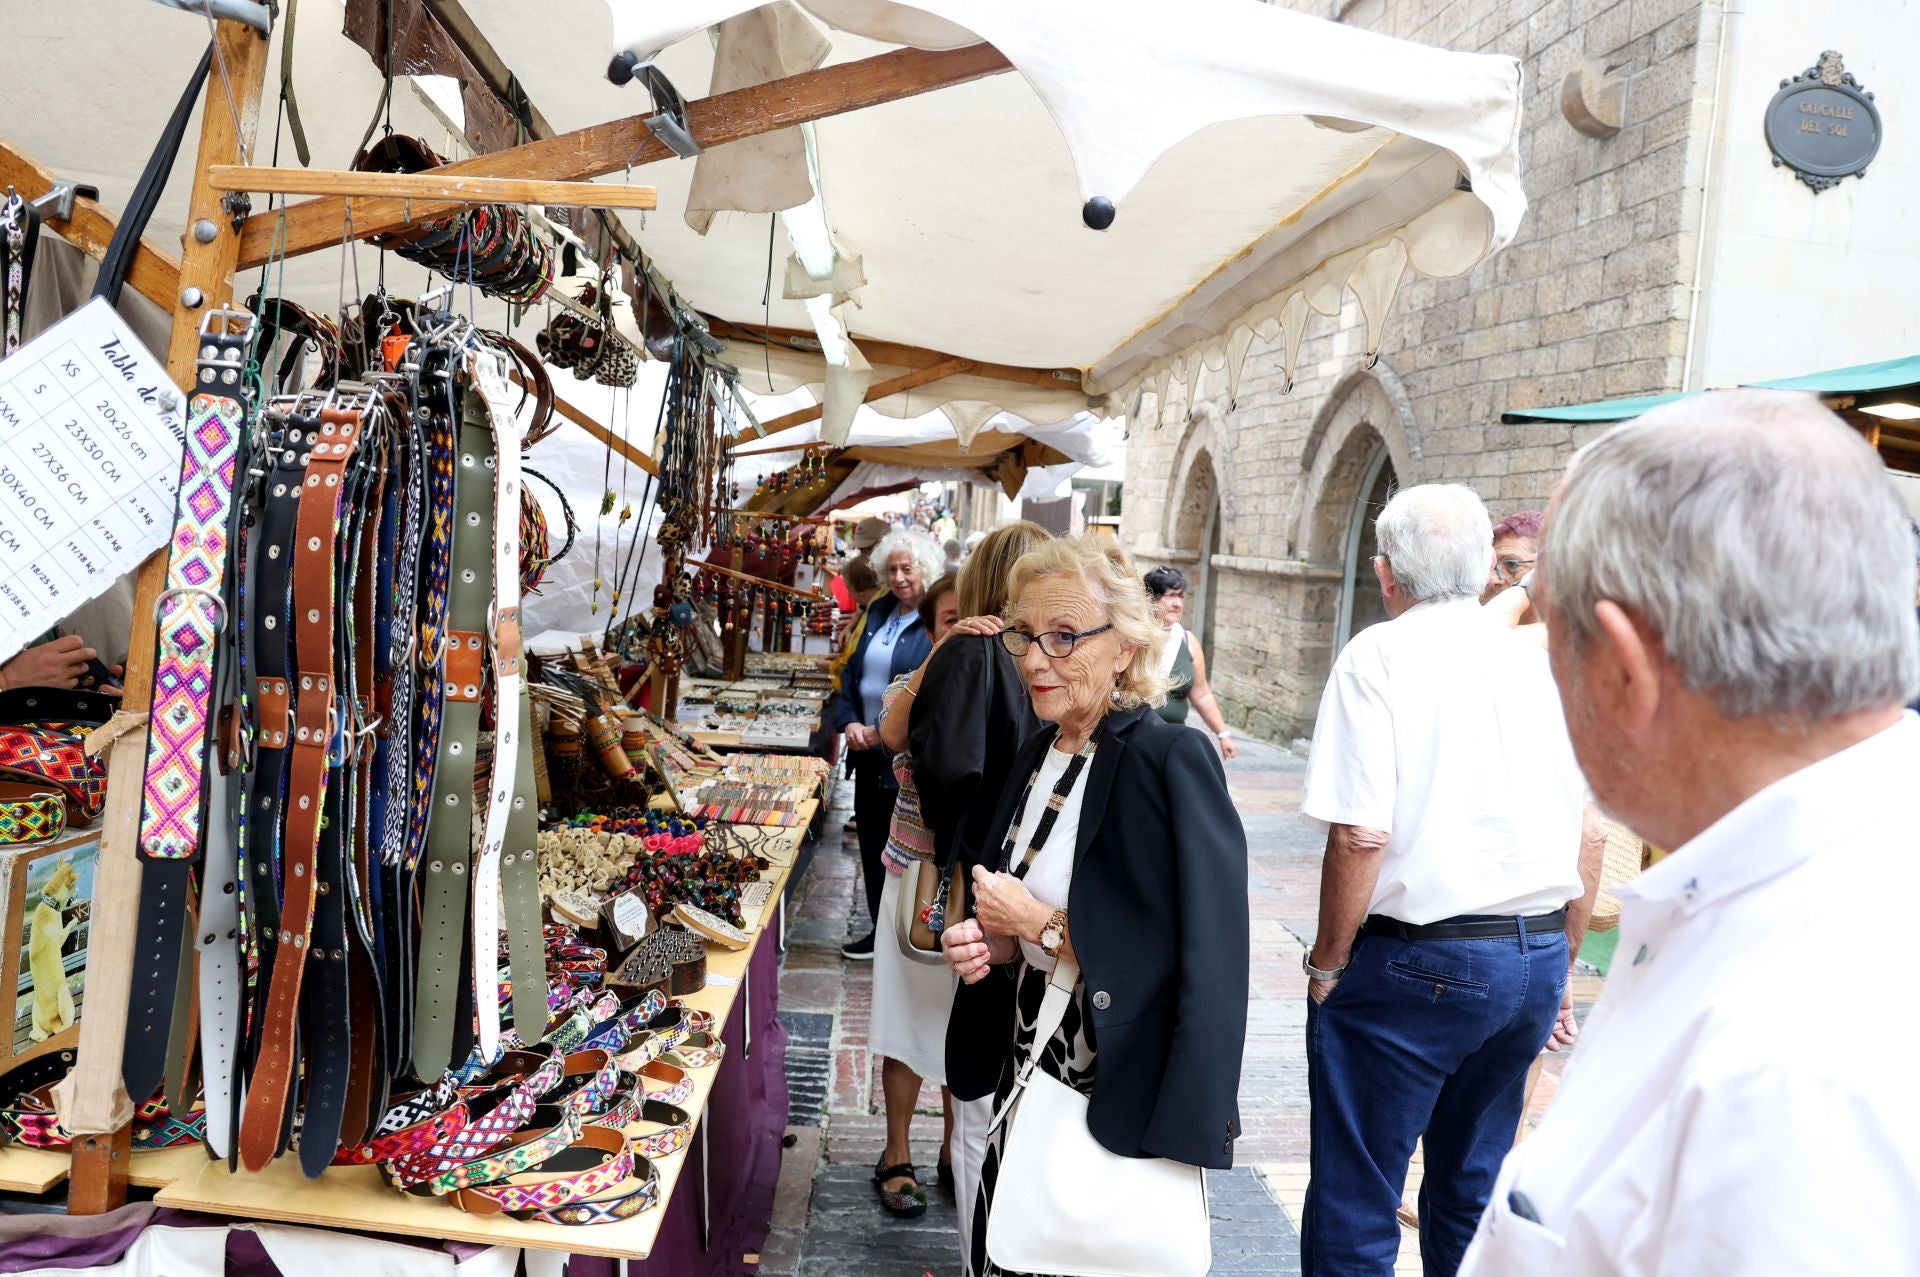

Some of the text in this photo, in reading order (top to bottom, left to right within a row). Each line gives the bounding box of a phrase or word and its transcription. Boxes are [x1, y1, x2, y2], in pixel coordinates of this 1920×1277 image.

[1801, 119, 1848, 137] DEL SOL
[100, 330, 138, 383] Tabla
[137, 386, 158, 406] de
[61, 359, 81, 378] XS
[96, 400, 133, 440] 20x26
[130, 442, 147, 460] cm
[34, 384, 48, 395] S
[64, 419, 103, 460] 23X30
[101, 461, 121, 483] CM
[143, 512, 154, 526] kg
[32, 442, 69, 482] 27X36
[68, 483, 88, 505] CM
[111, 539, 122, 552] kg
[0, 530, 60, 597] CM 18/25 kg
[33, 508, 54, 531] CM
[67, 541, 88, 563] 11/18
[85, 561, 96, 575] kg
[0, 583, 31, 618] 25/38 kg
